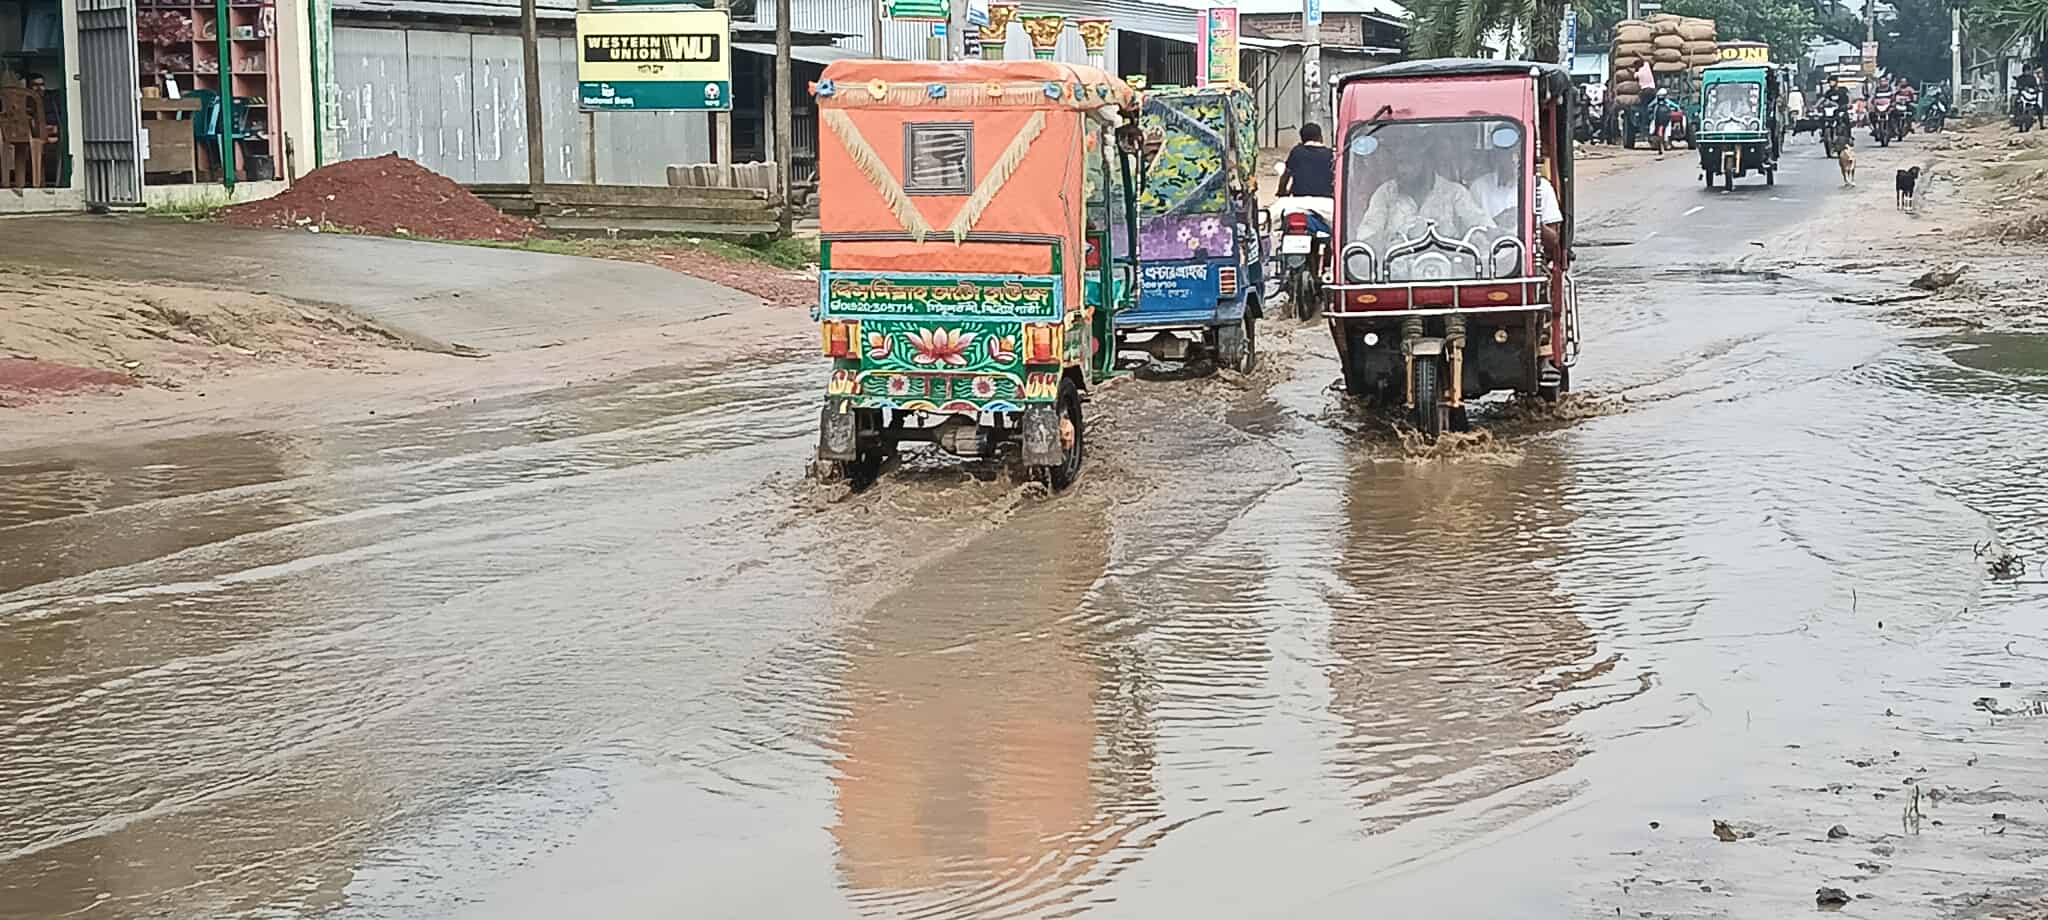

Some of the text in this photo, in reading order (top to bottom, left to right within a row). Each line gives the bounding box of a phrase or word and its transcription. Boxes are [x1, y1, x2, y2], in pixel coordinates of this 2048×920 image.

[587, 37, 661, 49] WESTERN
[669, 36, 712, 60] WU
[609, 48, 661, 60] UNION
